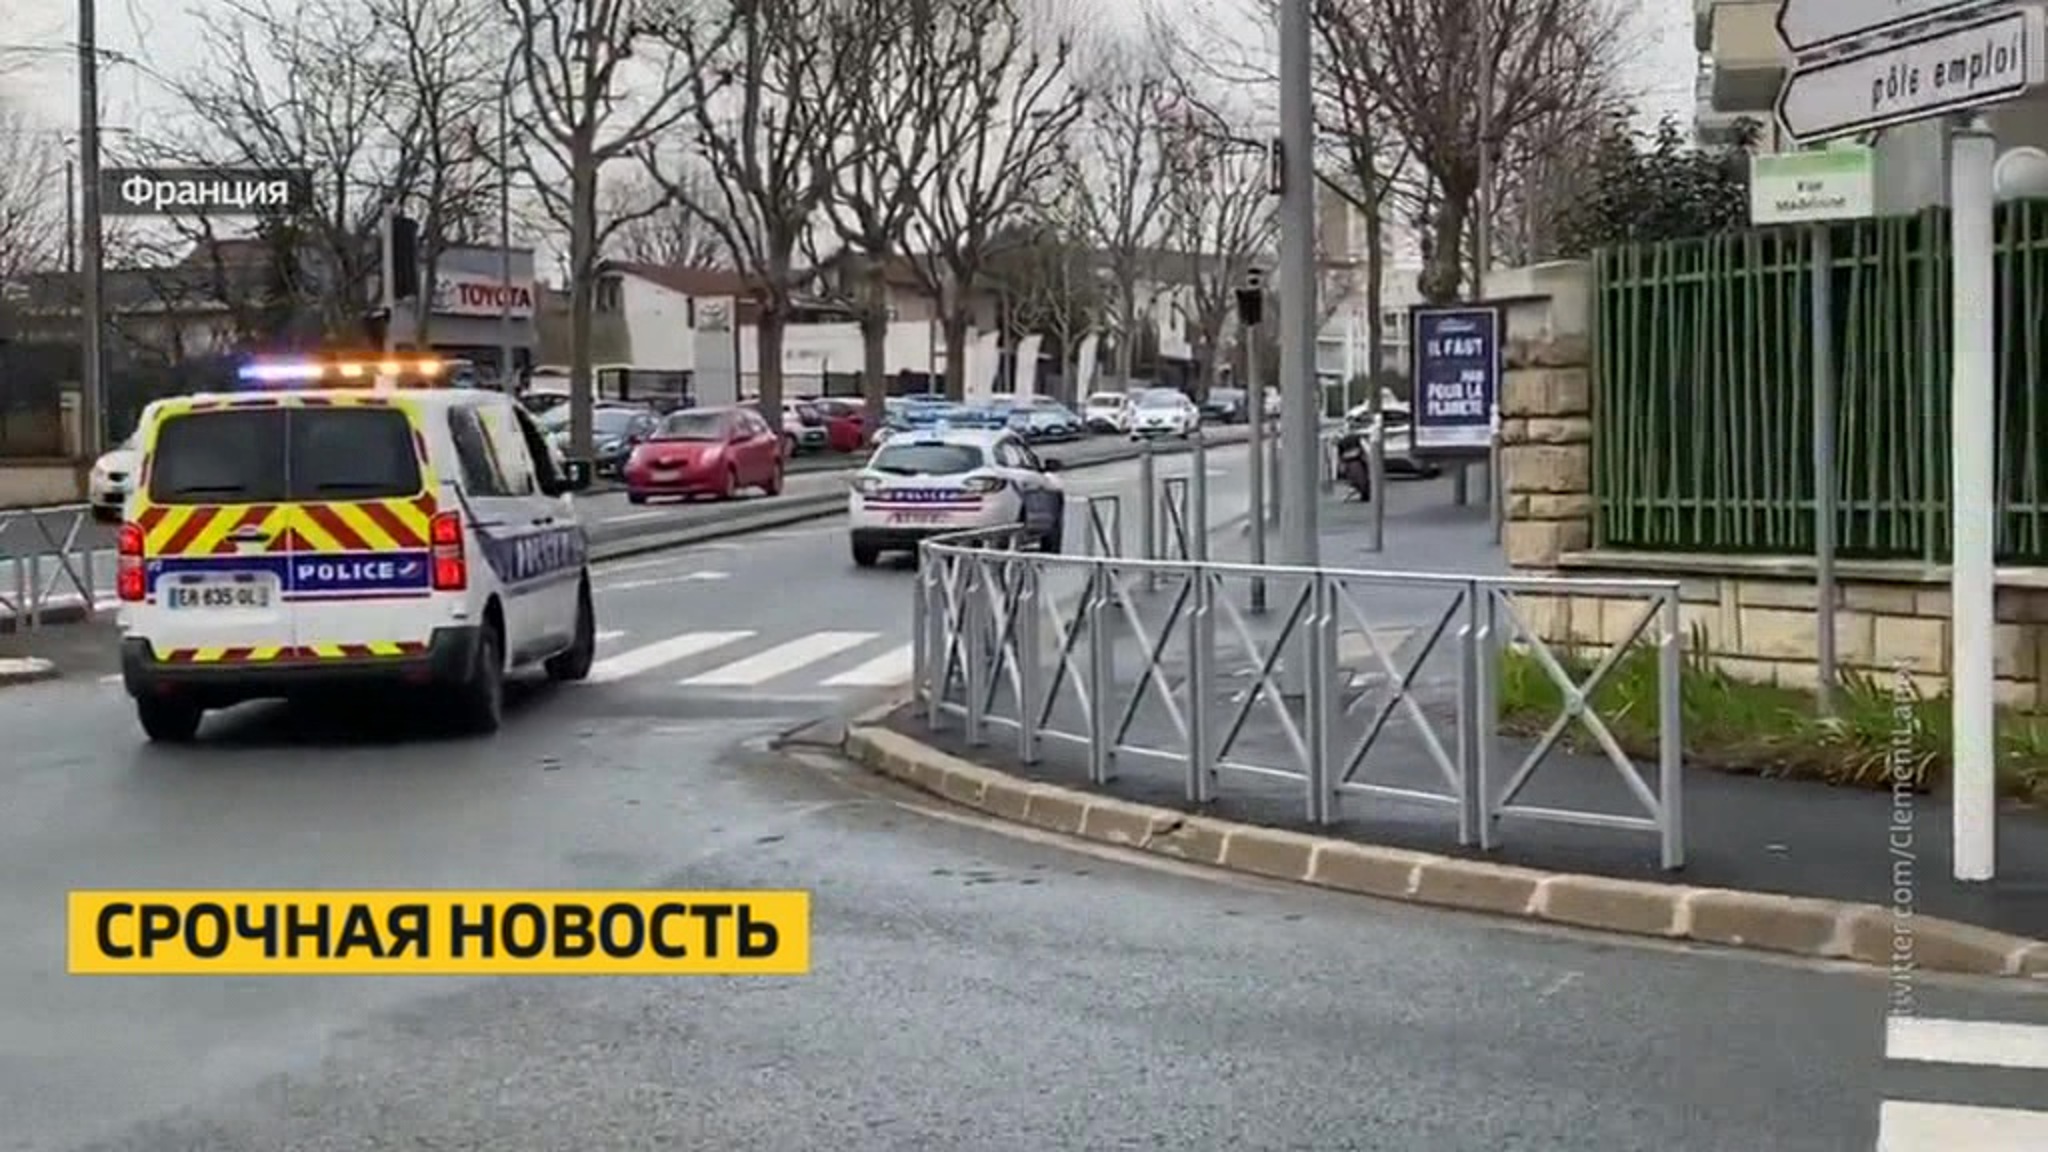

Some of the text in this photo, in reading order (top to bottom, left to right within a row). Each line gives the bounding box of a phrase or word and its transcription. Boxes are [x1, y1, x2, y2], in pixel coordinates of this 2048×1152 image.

[1872, 31, 2018, 111] pôle emploi
[458, 282, 532, 307] TOYOTA
[299, 562, 395, 581] POLICE
